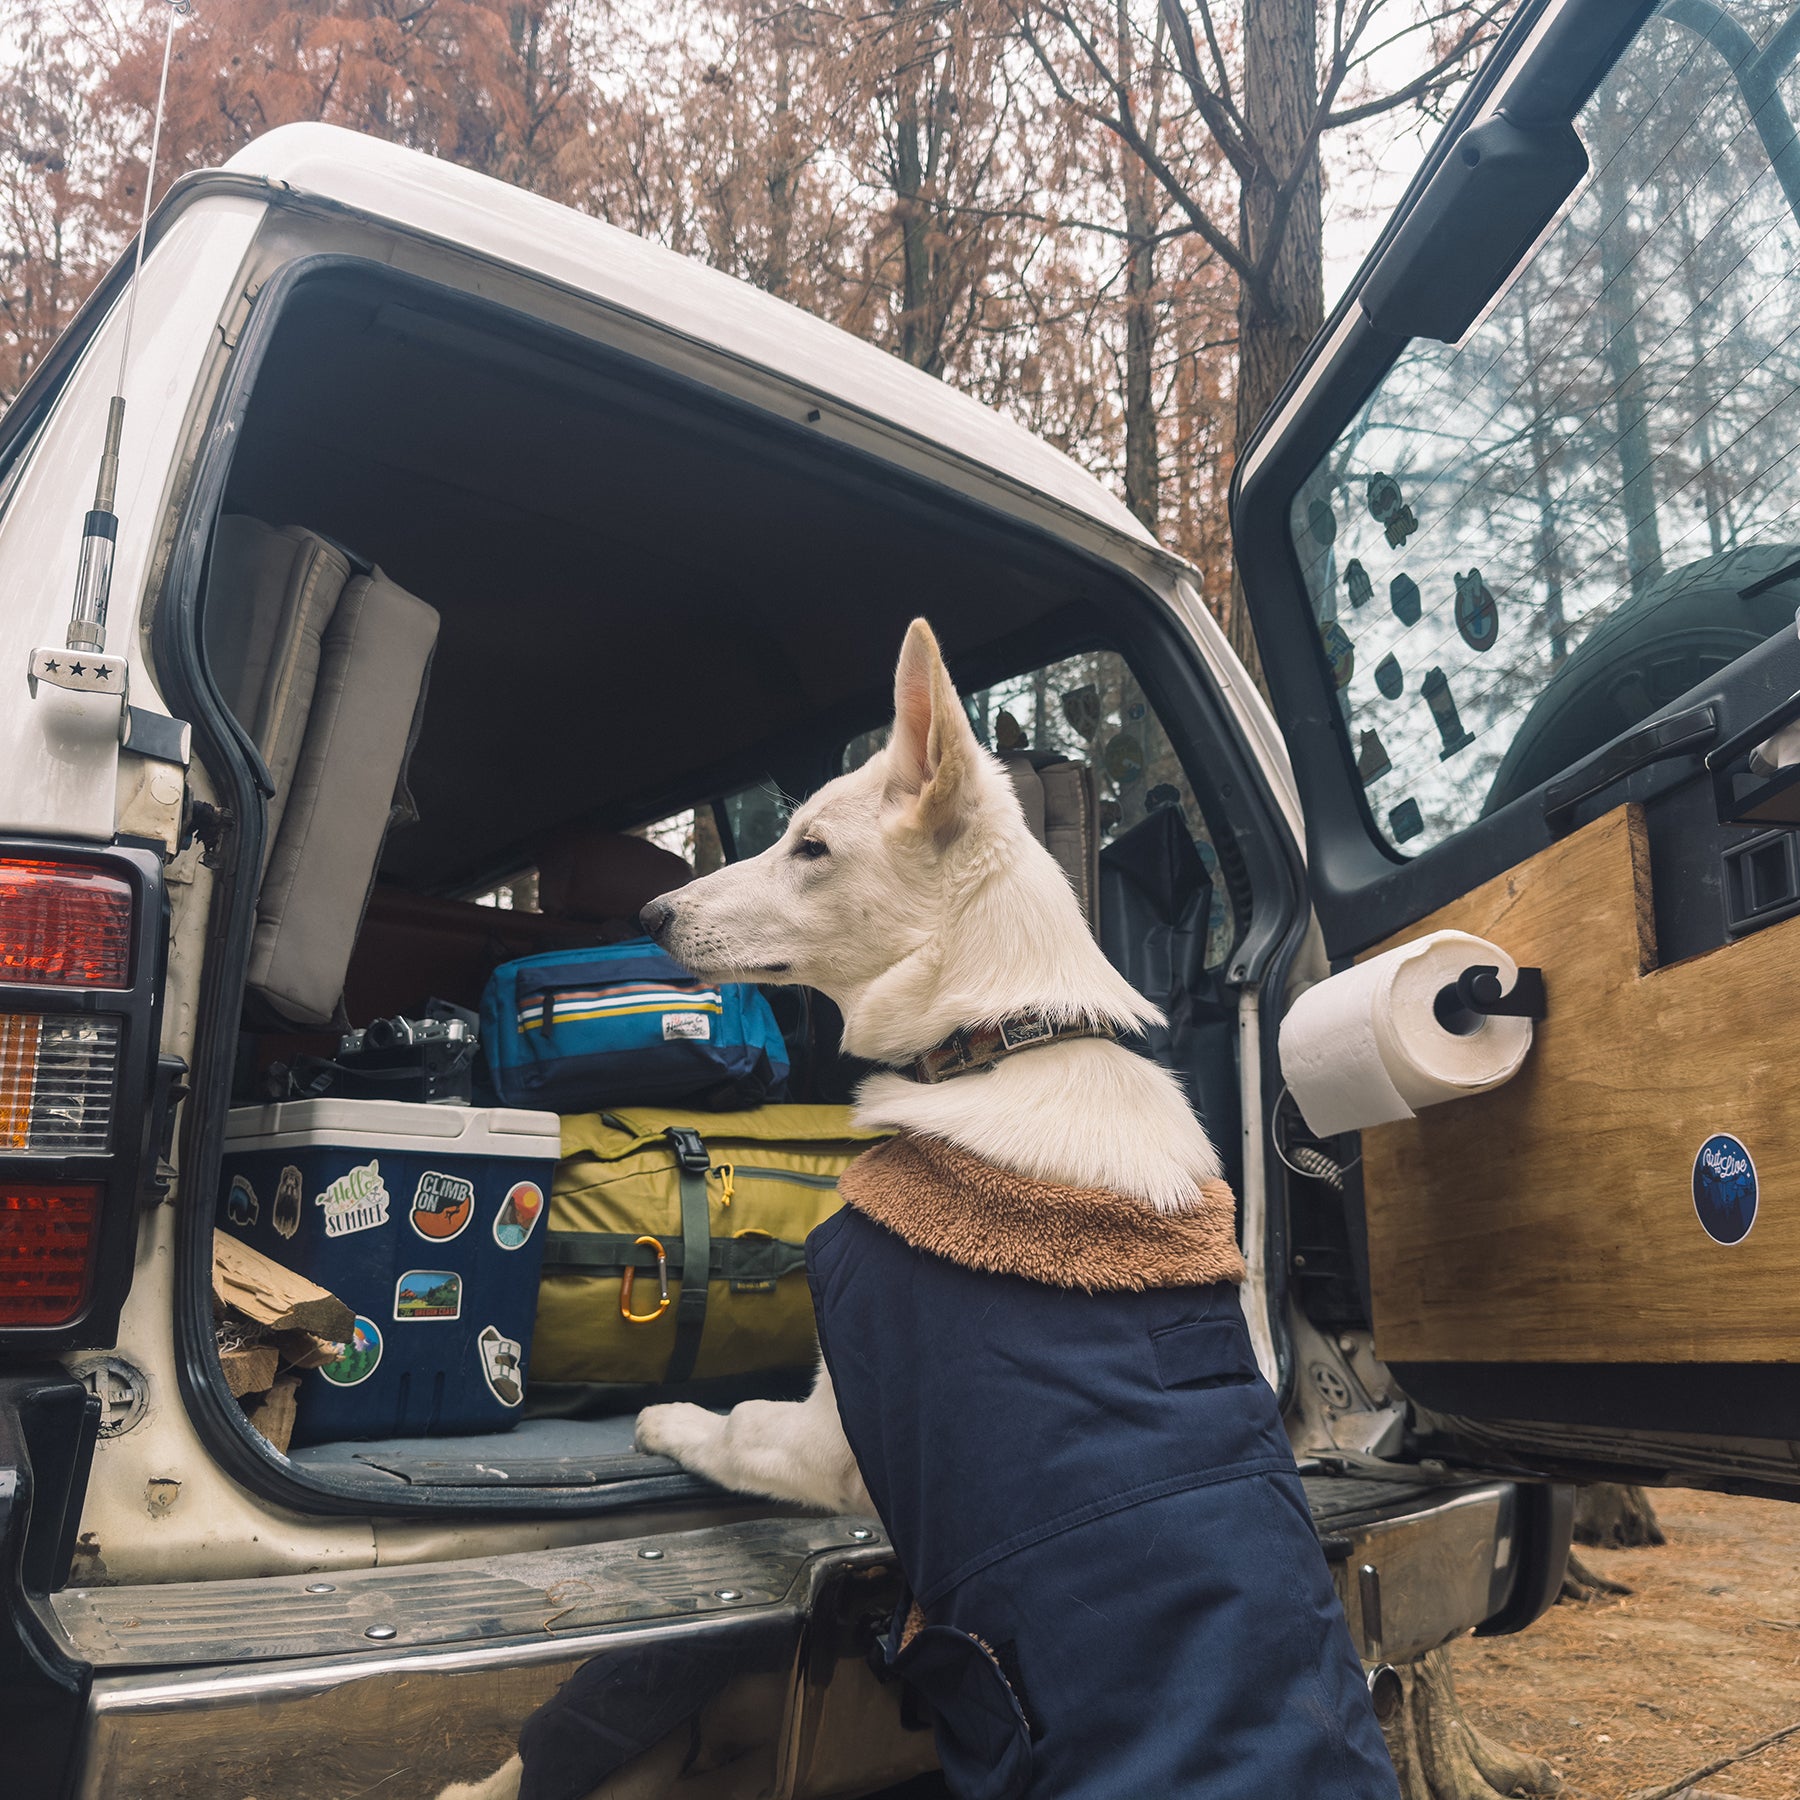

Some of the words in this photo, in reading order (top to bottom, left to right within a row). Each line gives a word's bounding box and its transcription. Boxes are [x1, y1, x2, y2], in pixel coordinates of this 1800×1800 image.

[1720, 1152, 1747, 1178] Live
[332, 1169, 374, 1205] Hello
[422, 1175, 468, 1201] CLIMB
[418, 1192, 439, 1212] ON
[328, 1204, 387, 1233] SUMMER
